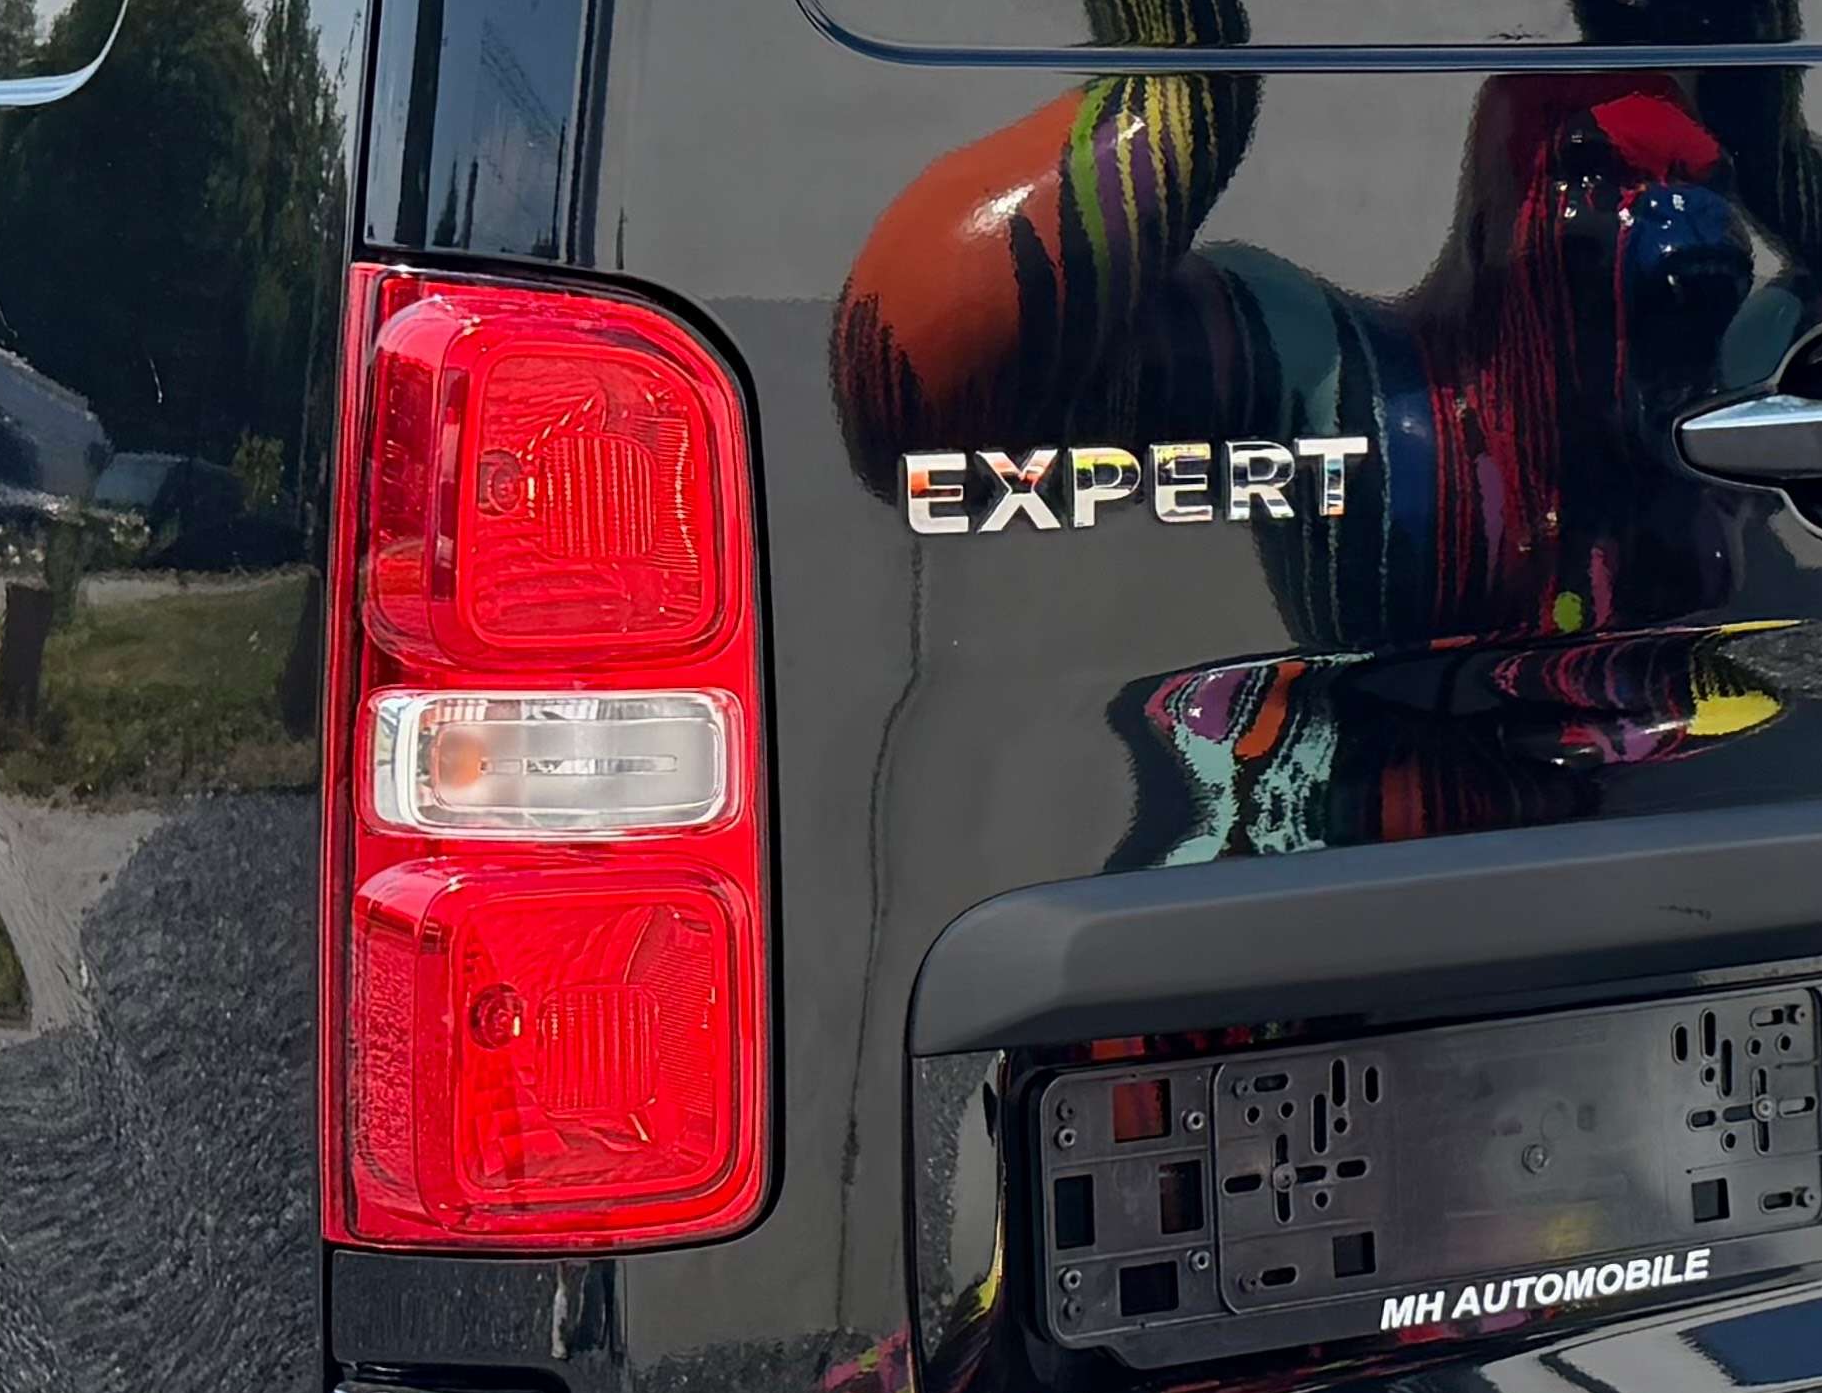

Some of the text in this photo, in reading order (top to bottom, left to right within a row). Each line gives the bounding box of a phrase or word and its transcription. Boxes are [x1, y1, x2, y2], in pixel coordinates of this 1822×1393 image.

[904, 437, 1368, 535] EXPERT
[1380, 1248, 1711, 1330] MH AUTOMOBILE
